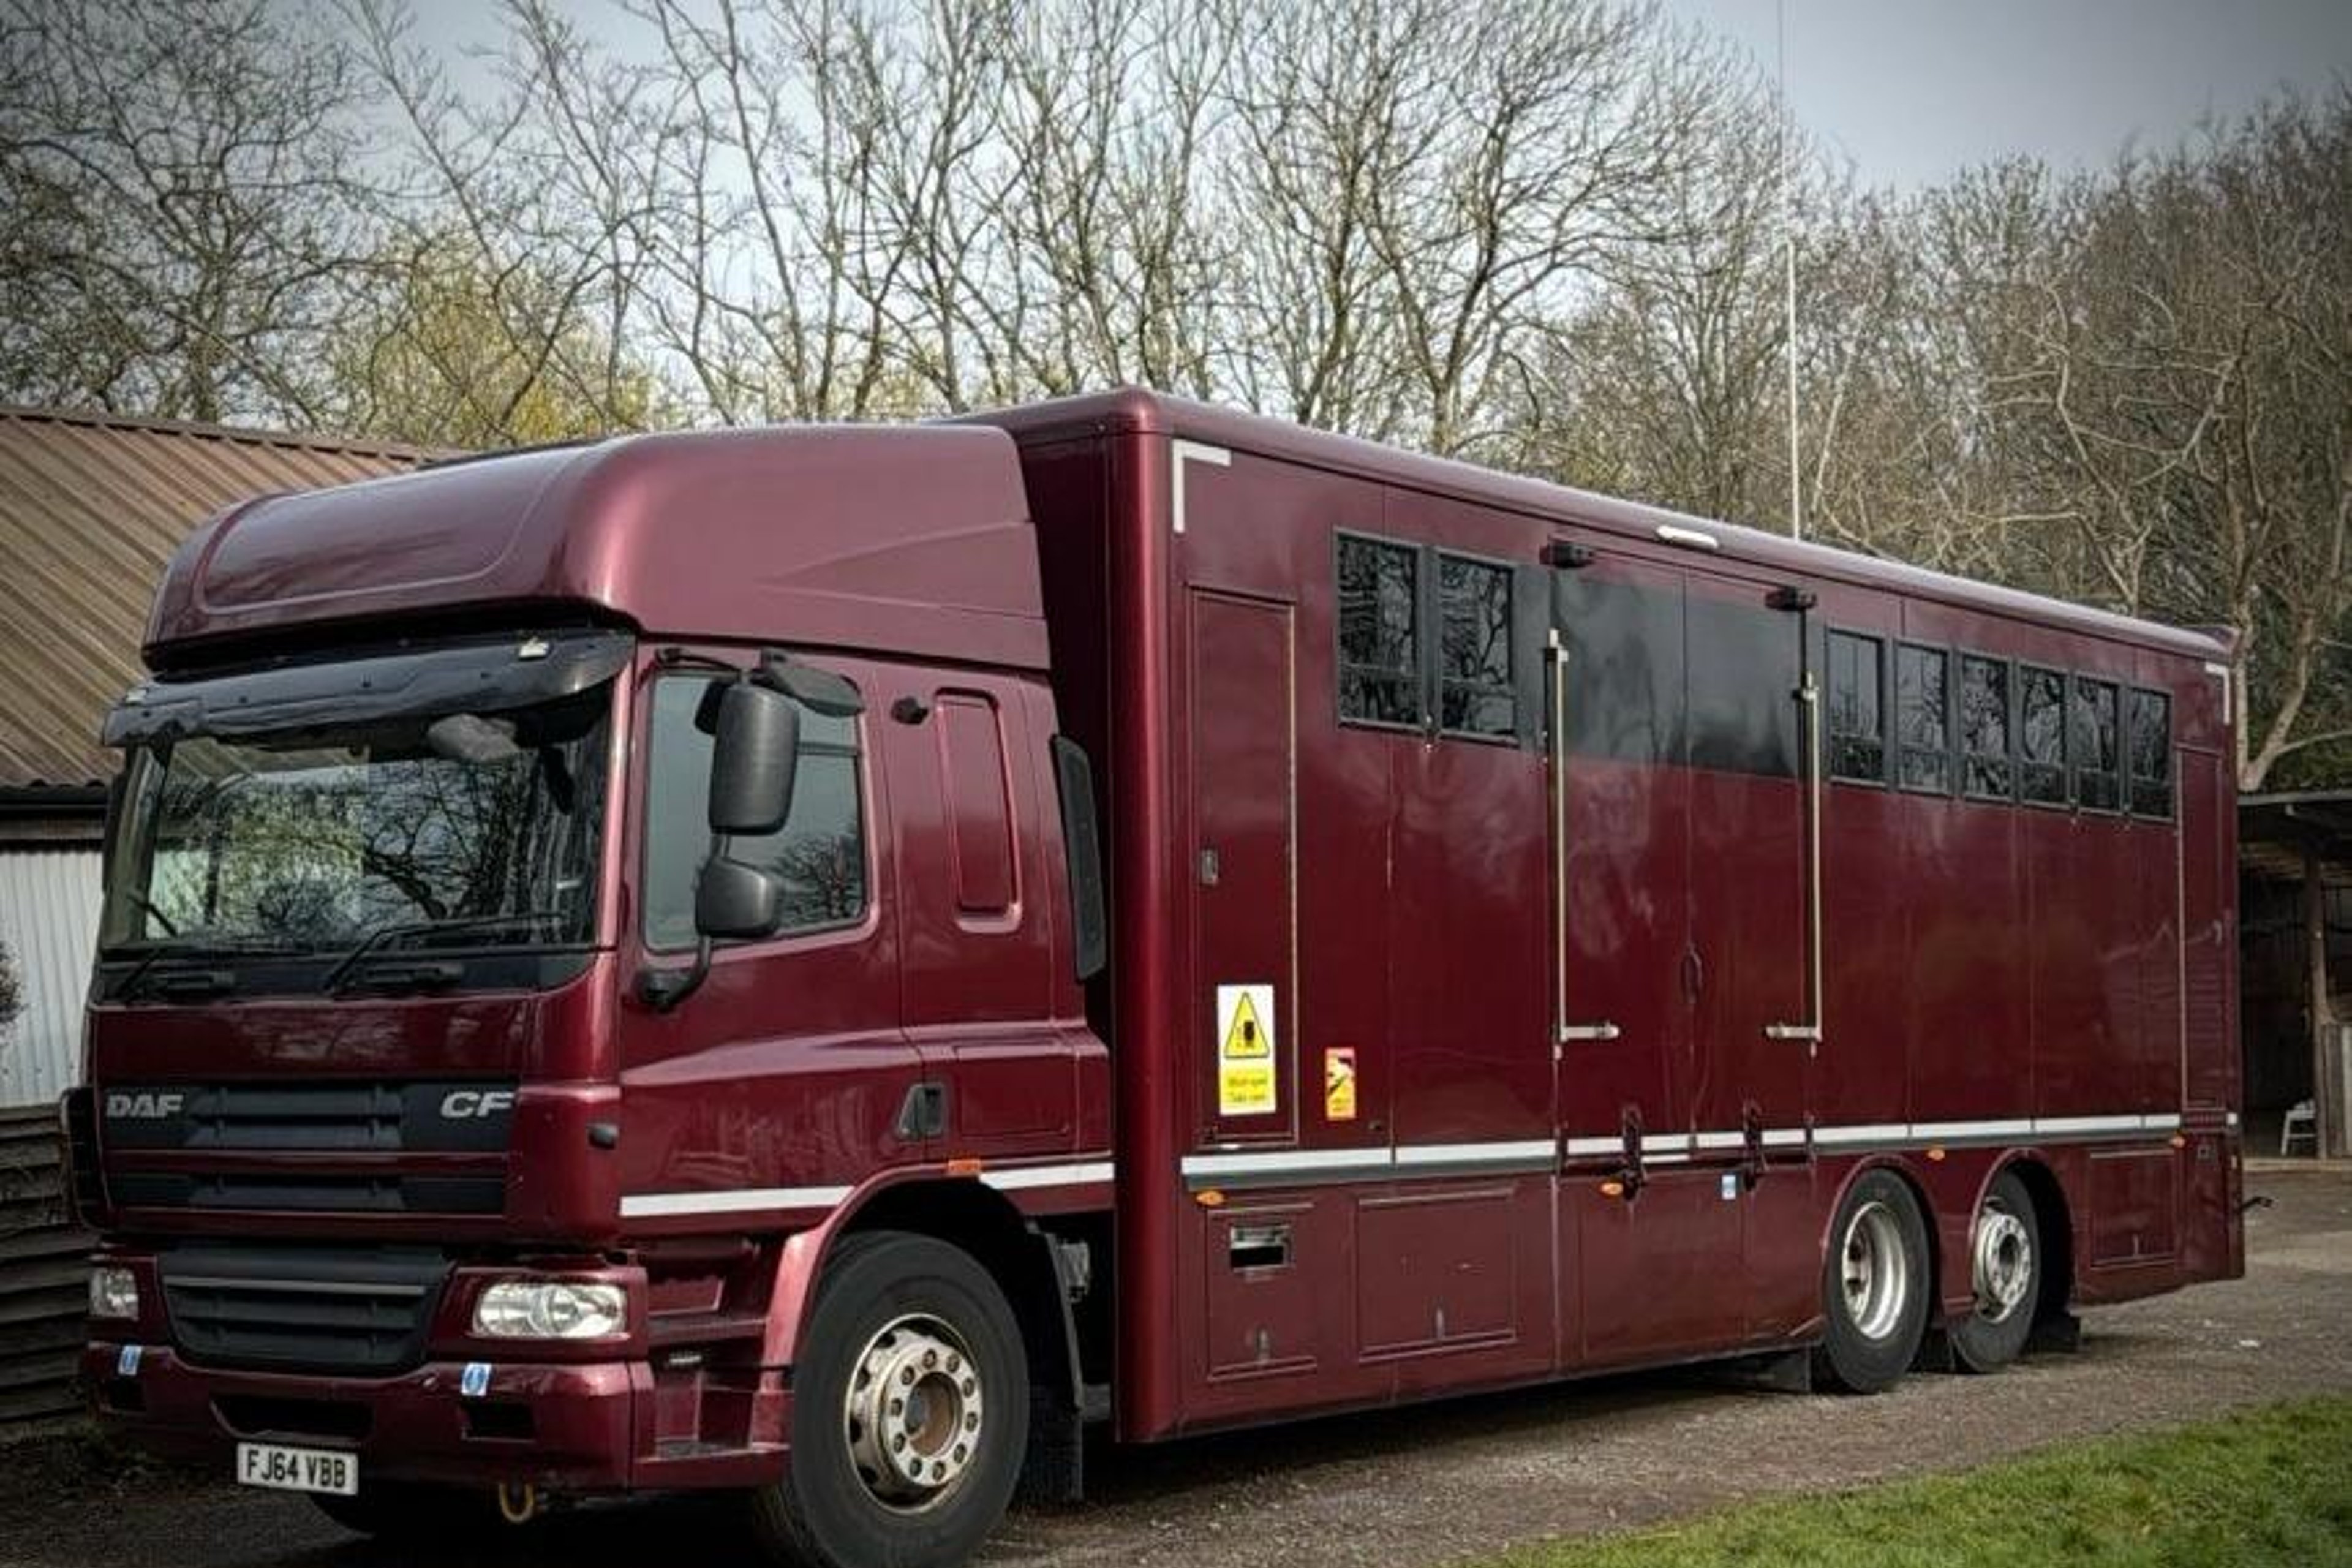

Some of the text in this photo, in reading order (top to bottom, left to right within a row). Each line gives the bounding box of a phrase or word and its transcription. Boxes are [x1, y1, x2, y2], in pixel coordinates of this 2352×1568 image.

[107, 1094, 183, 1117] DAF
[441, 1091, 514, 1117] CF
[247, 1449, 346, 1488] FJ64 VBB
